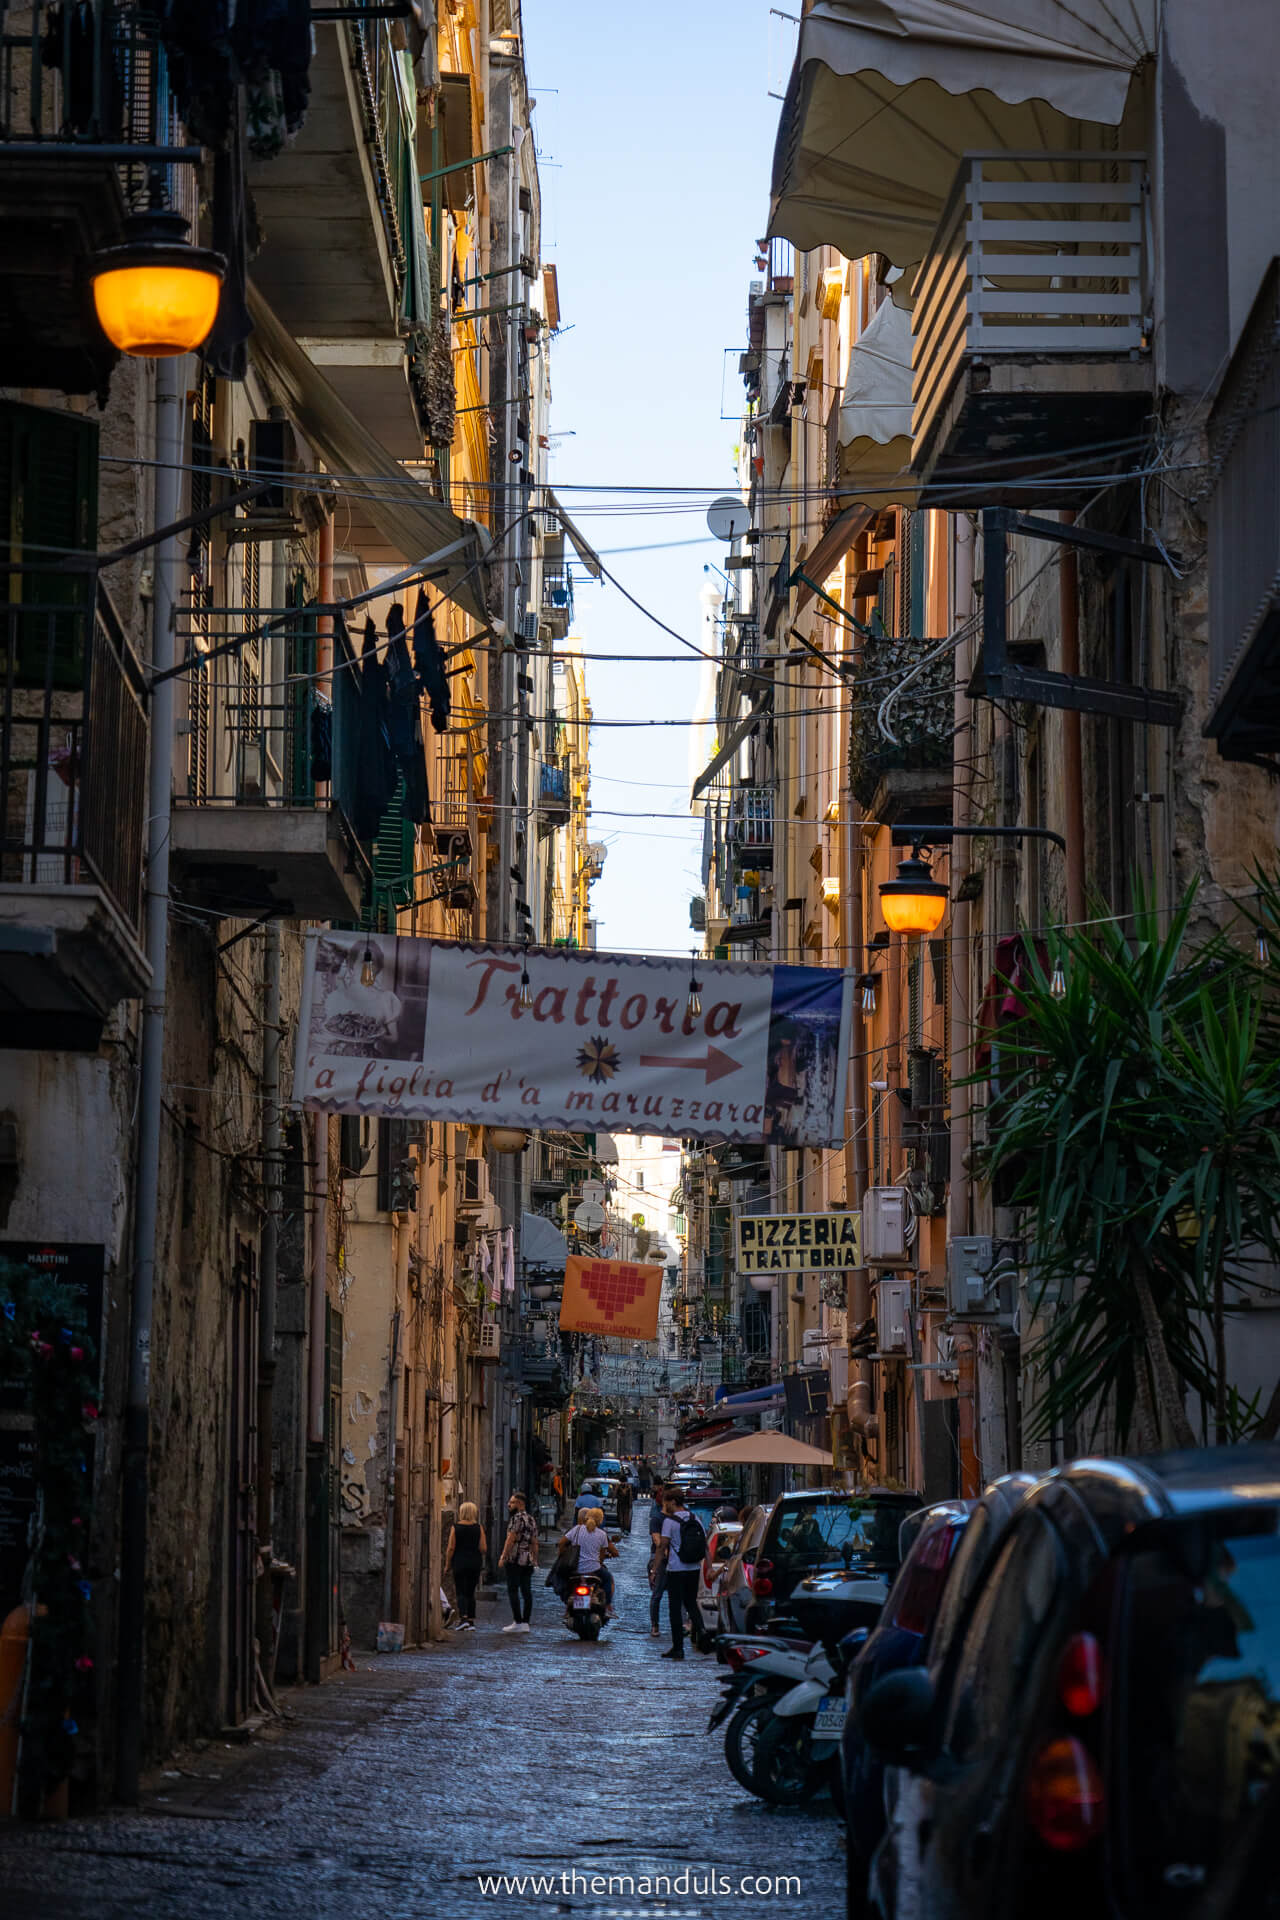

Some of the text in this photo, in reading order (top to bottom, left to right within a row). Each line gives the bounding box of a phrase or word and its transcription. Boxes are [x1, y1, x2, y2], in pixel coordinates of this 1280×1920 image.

[464, 958, 743, 1039] Trattoria
[355, 1060, 455, 1106] figlia
[564, 1090, 763, 1124] maruzzara
[740, 1217, 857, 1247] PIZZERIA
[27, 1254, 69, 1265] MARTINI
[742, 1248, 856, 1268] TRATTORIA
